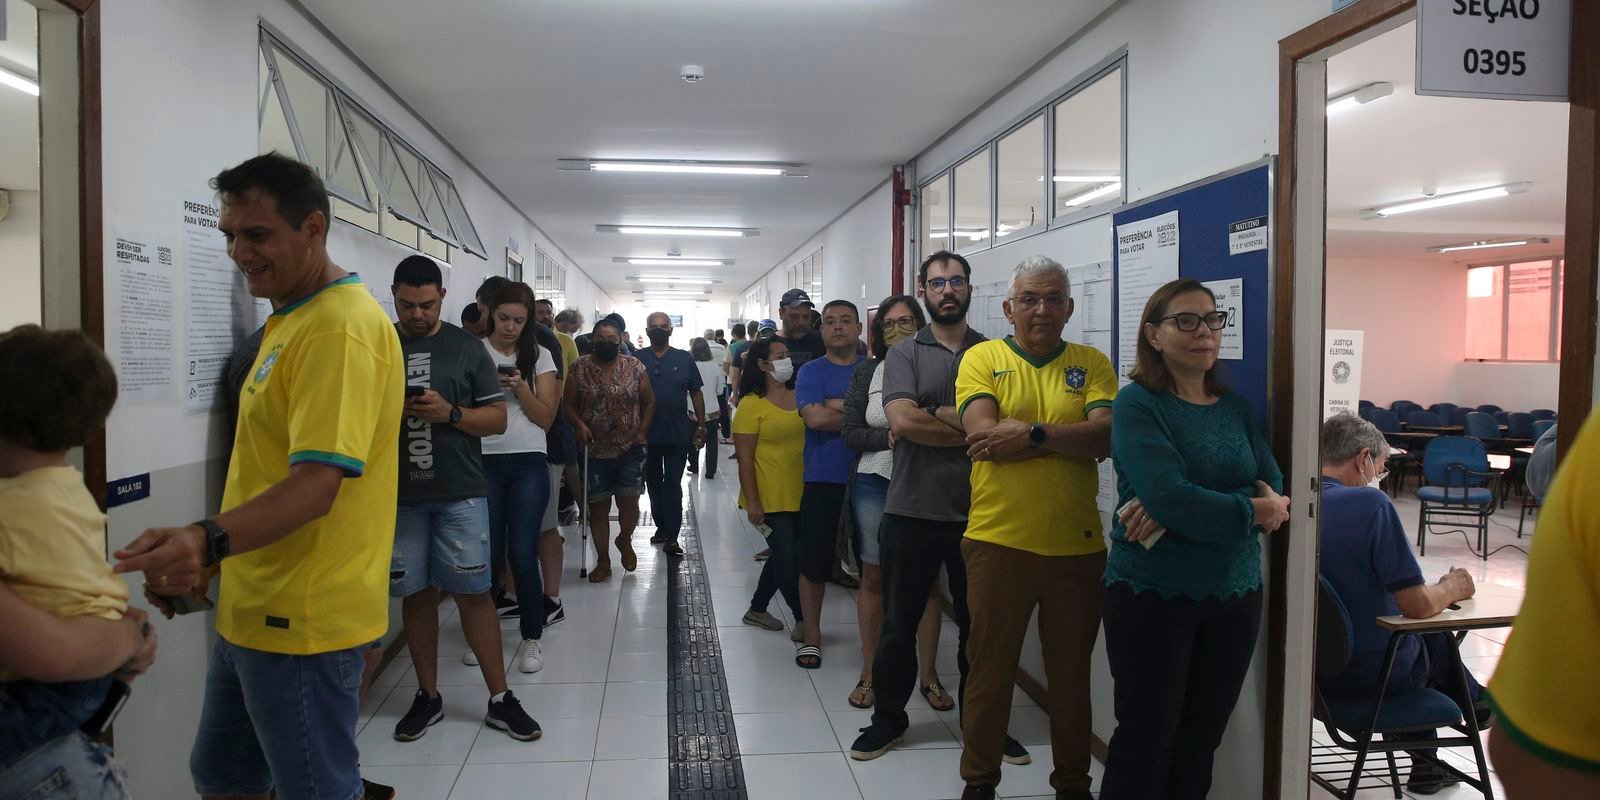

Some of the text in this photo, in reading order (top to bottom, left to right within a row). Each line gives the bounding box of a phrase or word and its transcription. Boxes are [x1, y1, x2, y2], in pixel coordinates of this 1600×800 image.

[1463, 48, 1526, 76] 0395
[184, 215, 218, 230] PARA VOTAR
[1156, 223, 1176, 232] ELEIÇÕES
[1235, 219, 1260, 231] MATUTINO
[1120, 229, 1153, 245] PREFERÊNCIA
[116, 242, 132, 251] DEVEM
[133, 245, 142, 253] SER
[1120, 242, 1145, 255] PARA VOTAR
[116, 250, 150, 264] RESPEITADAS
[1333, 339, 1353, 347] JUSTIÇA
[1329, 348, 1355, 356] ELEITORAL
[407, 415, 433, 470] STOP
[117, 483, 133, 495] SALA
